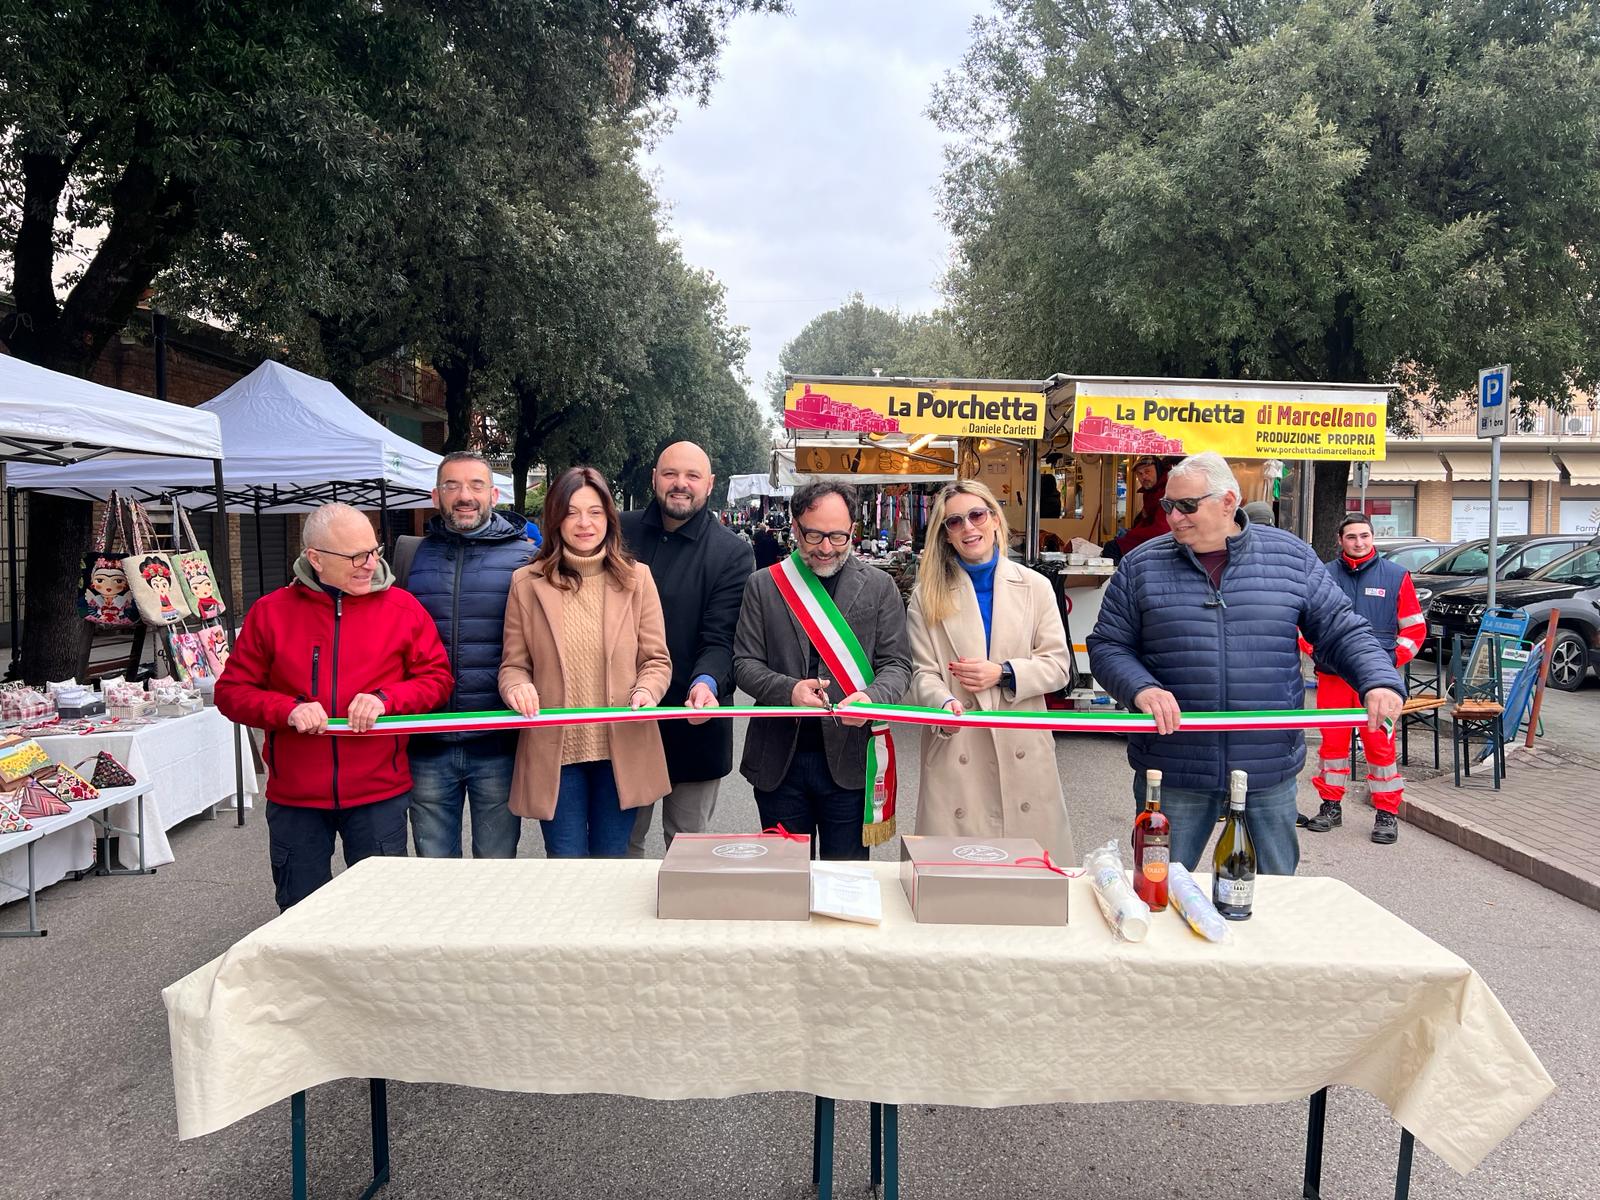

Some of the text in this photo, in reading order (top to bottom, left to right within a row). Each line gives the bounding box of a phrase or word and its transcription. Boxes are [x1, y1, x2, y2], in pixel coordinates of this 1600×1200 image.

[1486, 378, 1500, 403] P
[888, 391, 1038, 422] La Porchetta
[1116, 399, 1377, 428] La Porchetta di Marcellano
[969, 422, 1002, 435] Daniele
[1003, 423, 1037, 436] Carletti
[1256, 431, 1376, 446] PRODUZIONE PROPRIA
[1255, 446, 1376, 456] www.porchettadimarcellano.it
